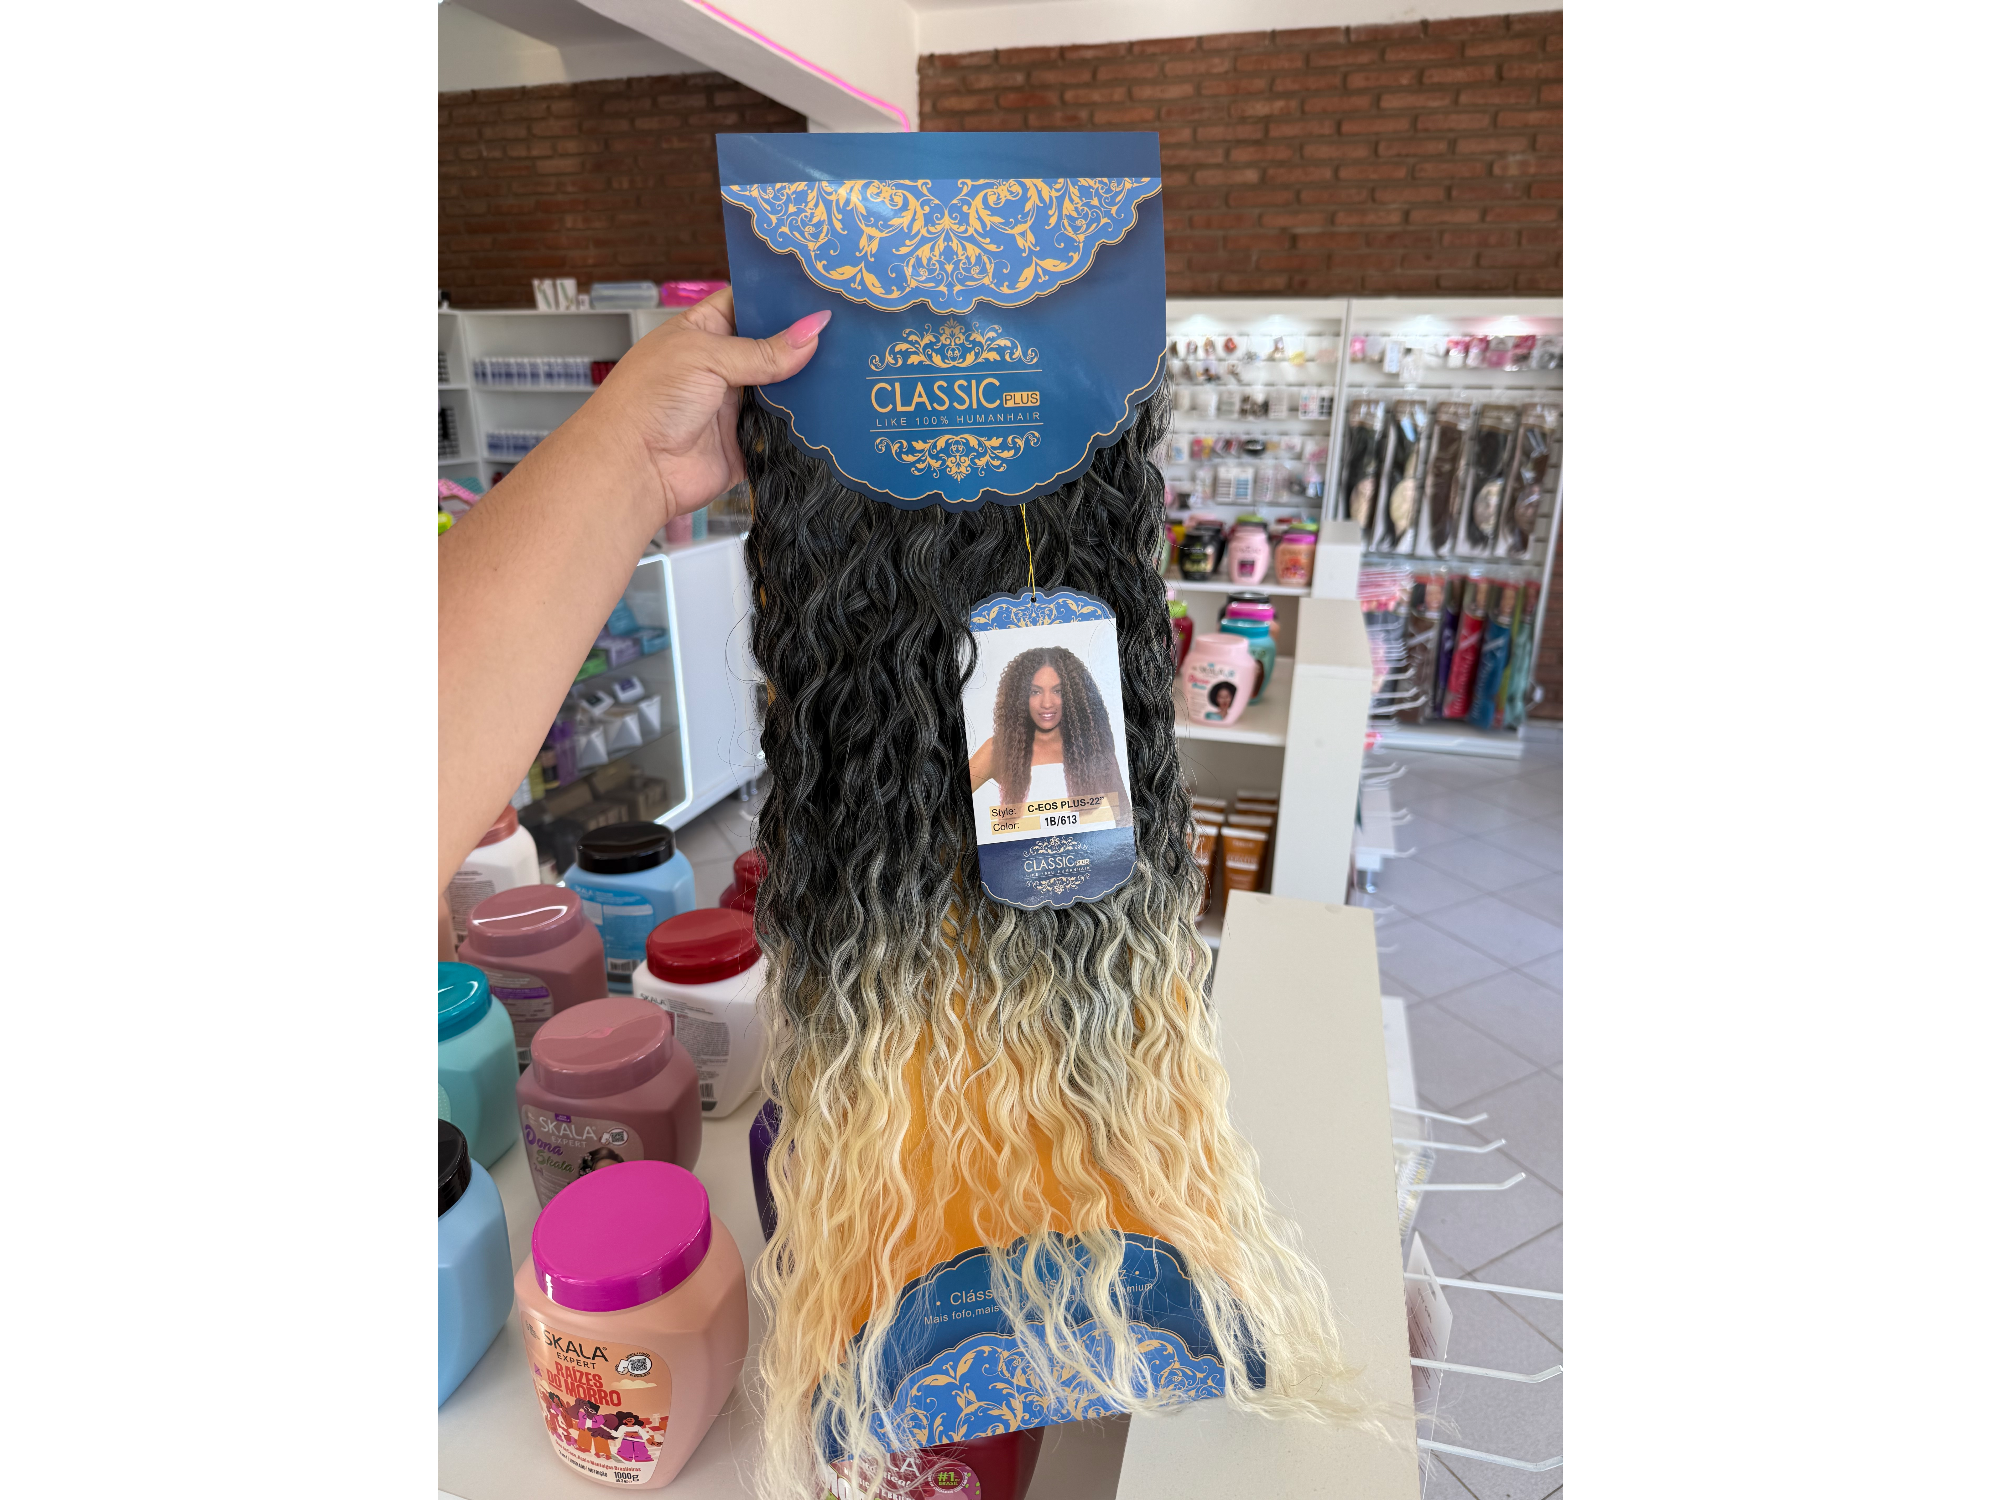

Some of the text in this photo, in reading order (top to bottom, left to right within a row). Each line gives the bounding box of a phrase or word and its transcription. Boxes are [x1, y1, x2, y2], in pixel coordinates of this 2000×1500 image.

[871, 378, 1039, 413] CLASSIC PLUS
[876, 412, 1040, 427] LIKE 100% HUMANHAIR
[991, 808, 1017, 818] Style:
[1027, 802, 1058, 813] C-EOS
[992, 815, 1078, 832] Color: 1B/613
[1024, 856, 1075, 872] CLASSIC
[539, 1116, 597, 1140] SKALA
[525, 1124, 563, 1156] Dona
[551, 1136, 587, 1148] EXPERT
[536, 1149, 575, 1173] Skala
[924, 1315, 949, 1325] Mais
[543, 1329, 609, 1362] SKALA
[556, 1351, 596, 1369] EXPERT
[555, 1360, 604, 1389] RAÍZES
[546, 1368, 622, 1407] DO MORRO
[614, 1471, 640, 1482] 1000g
[938, 1472, 954, 1481] #1
